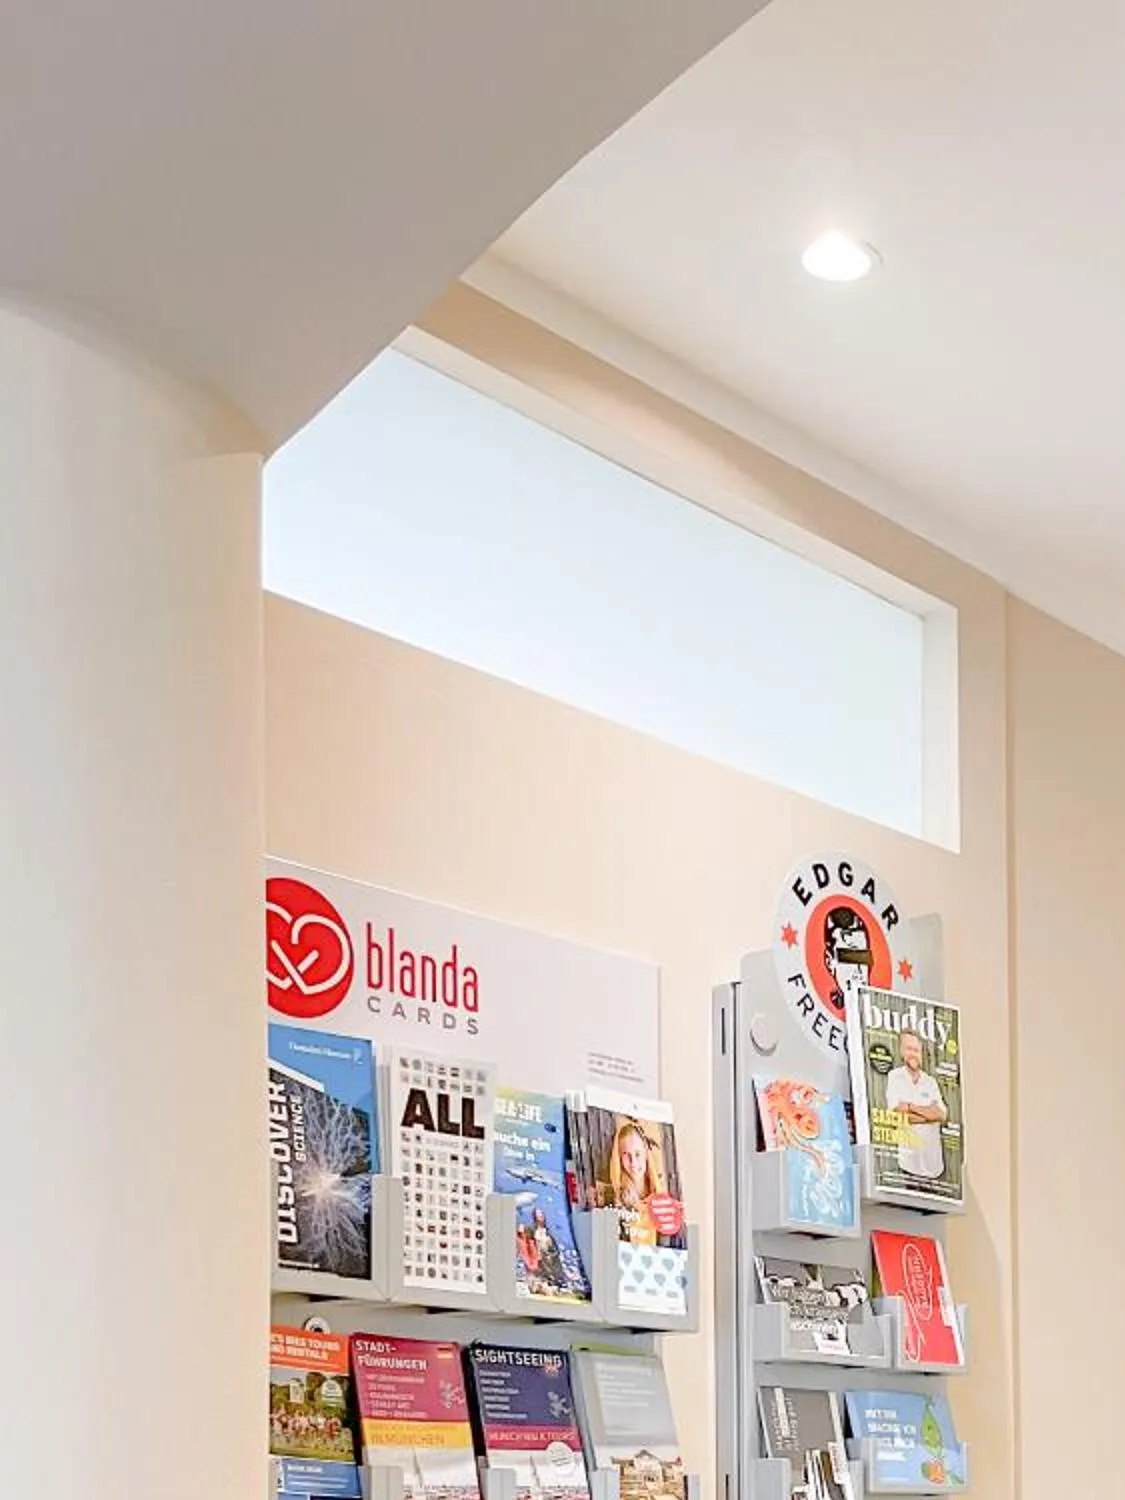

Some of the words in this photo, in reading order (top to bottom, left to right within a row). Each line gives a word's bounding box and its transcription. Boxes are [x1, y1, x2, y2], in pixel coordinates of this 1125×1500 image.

[792, 862, 899, 931] EDGAR
[366, 921, 479, 1013] blanda
[367, 995, 479, 1035] CARDS
[862, 993, 952, 1051] buddy
[400, 1088, 485, 1140] ALL
[268, 1082, 299, 1244] DISCOVER
[355, 1340, 397, 1353] STADT-
[357, 1353, 428, 1371] FÜHRUNGEN
[475, 1349, 563, 1368] SIGHTSEEING
